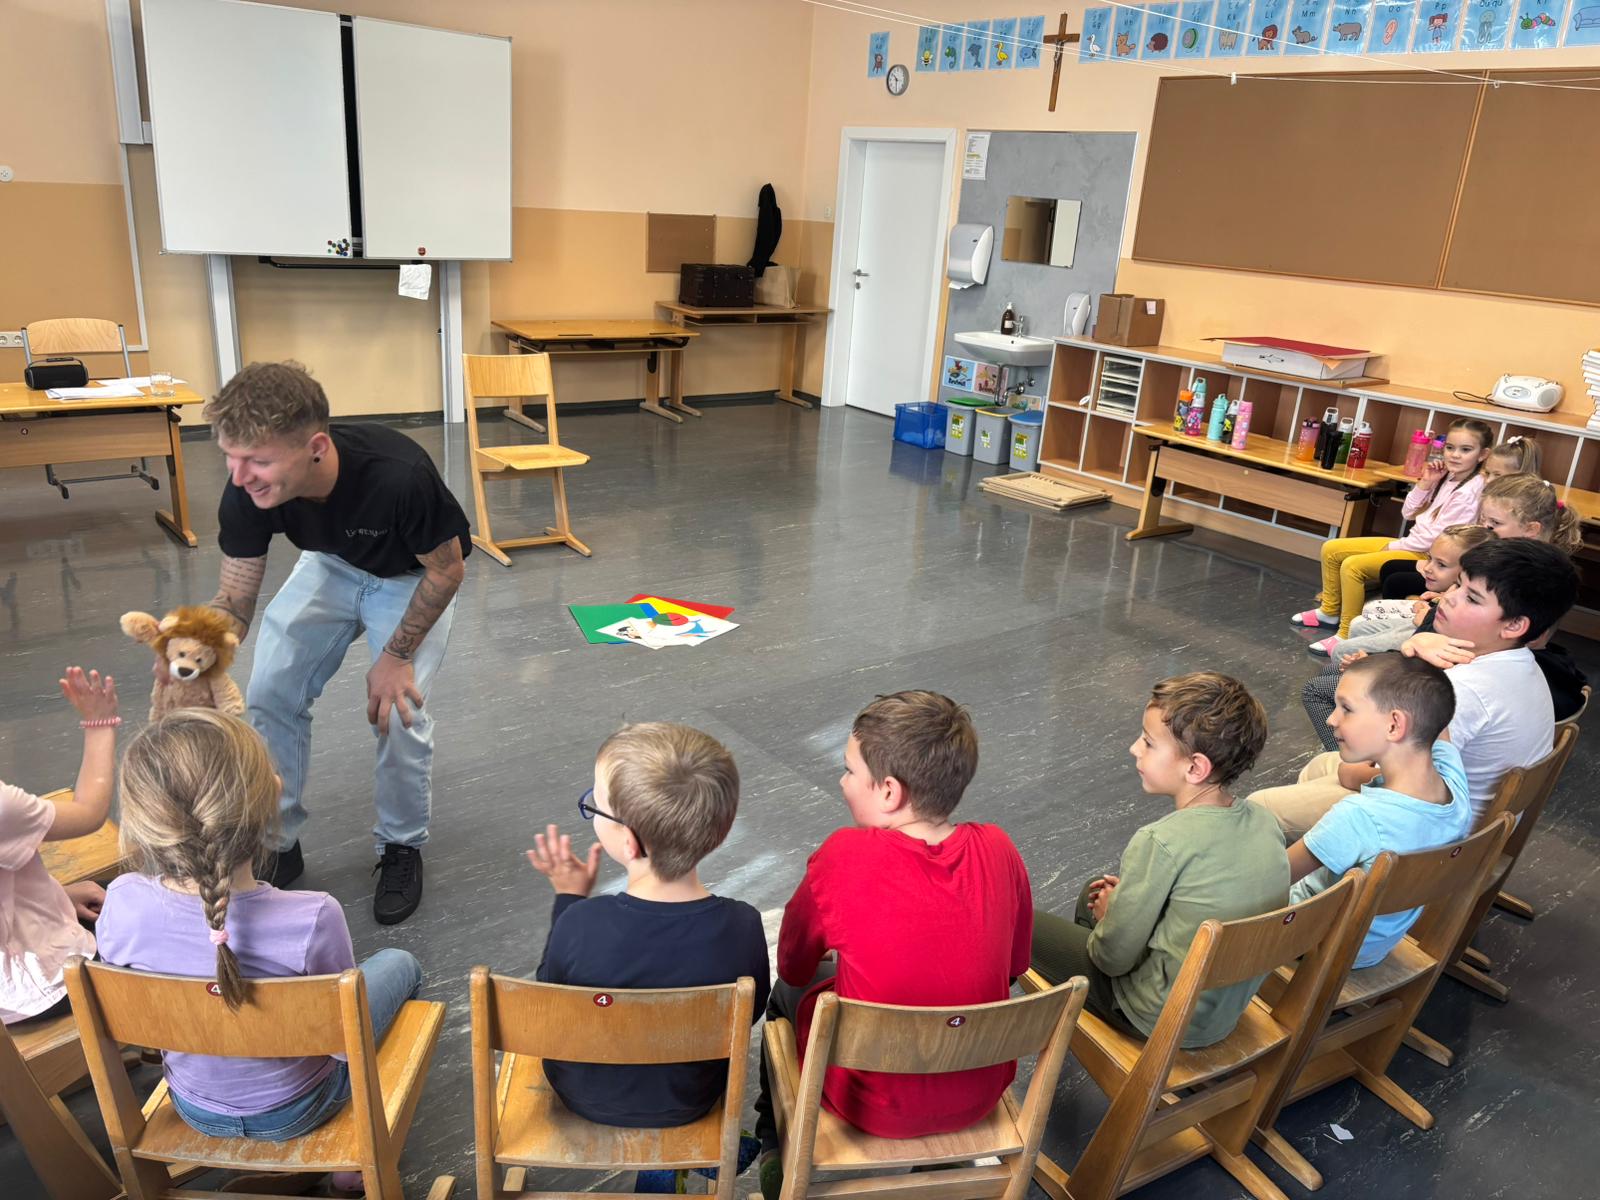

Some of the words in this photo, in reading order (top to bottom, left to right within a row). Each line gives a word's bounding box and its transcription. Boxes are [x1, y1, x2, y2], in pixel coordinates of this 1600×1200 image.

[210, 984, 221, 995] 4
[597, 995, 608, 1005] 4
[950, 1017, 961, 1026] 4
